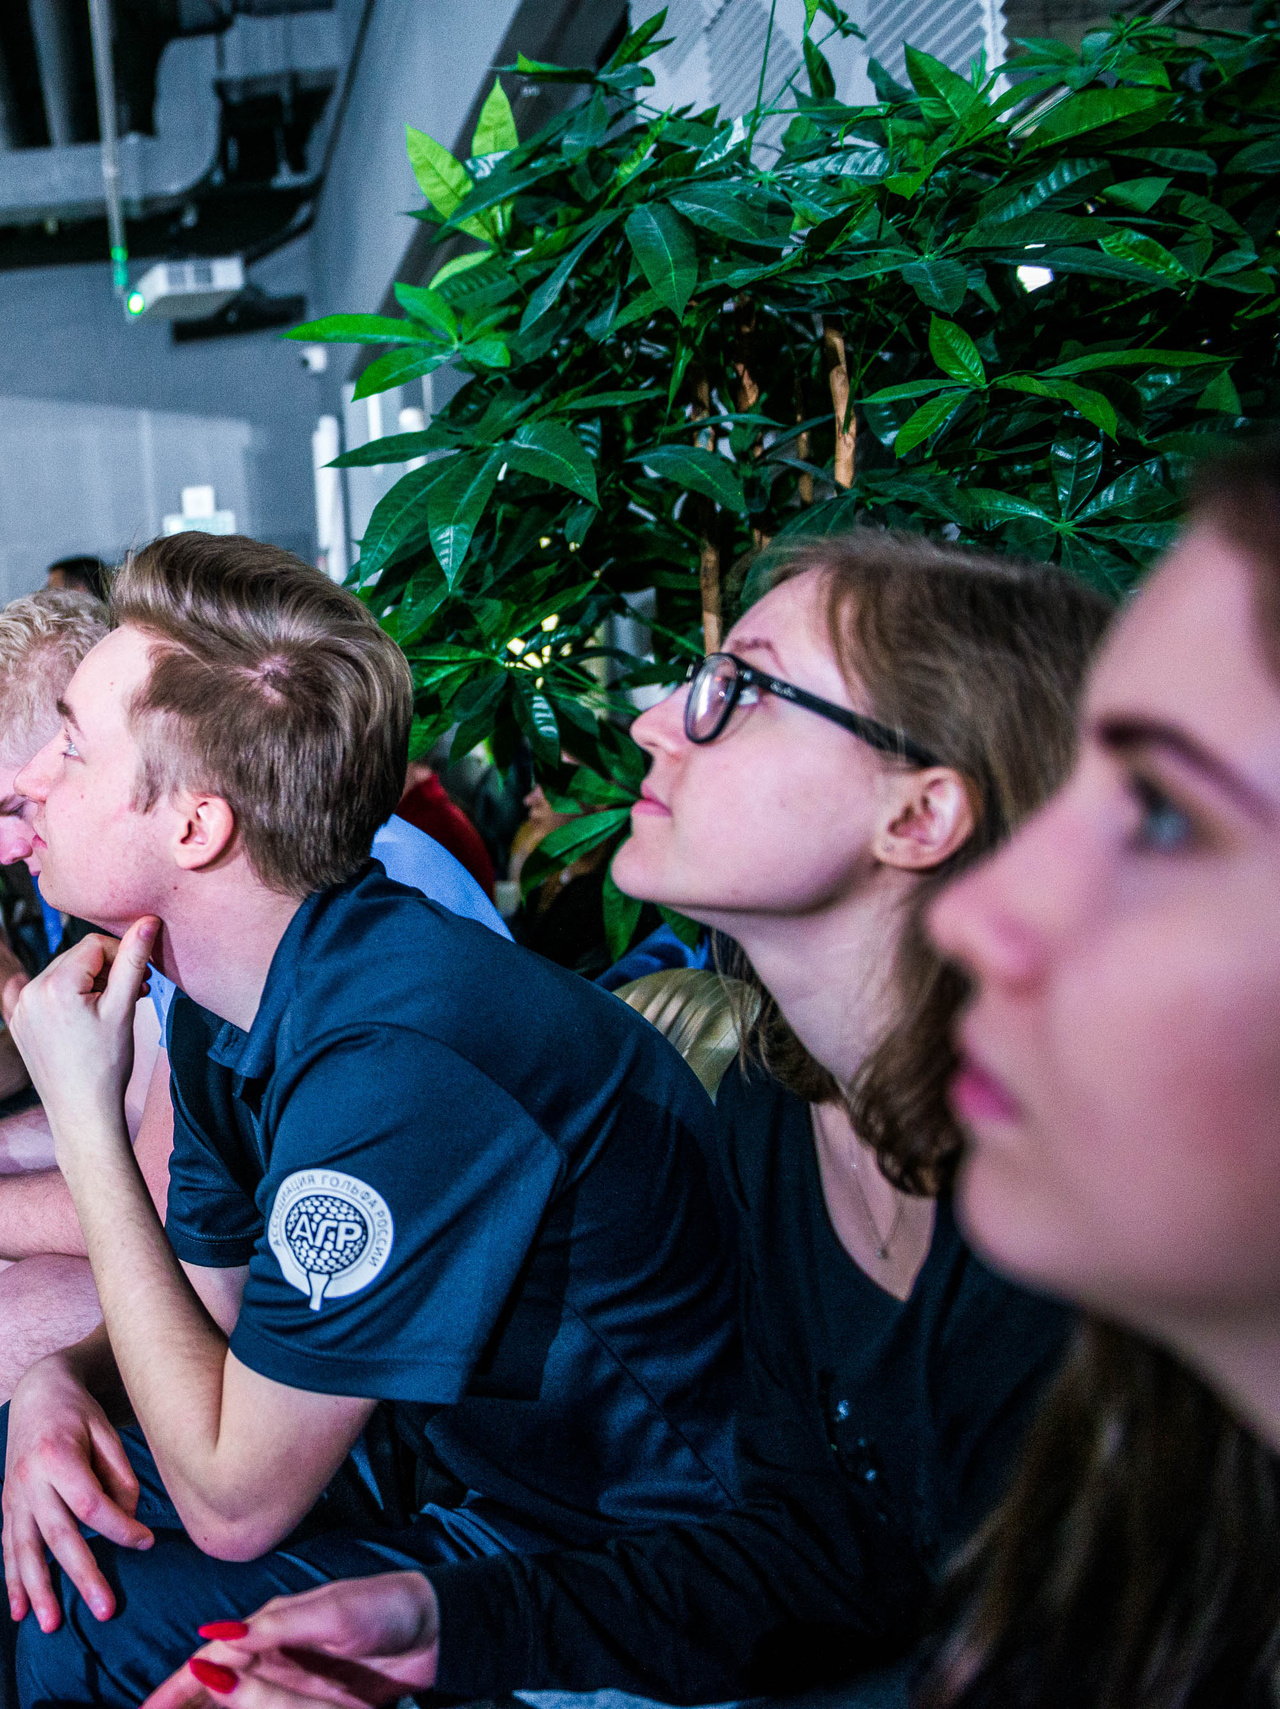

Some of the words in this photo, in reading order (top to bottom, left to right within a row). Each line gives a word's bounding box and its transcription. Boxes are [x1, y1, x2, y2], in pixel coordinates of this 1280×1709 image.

[271, 1174, 315, 1247] АССОЦИАЦИЯ
[321, 1174, 377, 1208] ГОЛЬФА
[370, 1210, 388, 1268] РОССИИ
[290, 1213, 363, 1252] АГР
